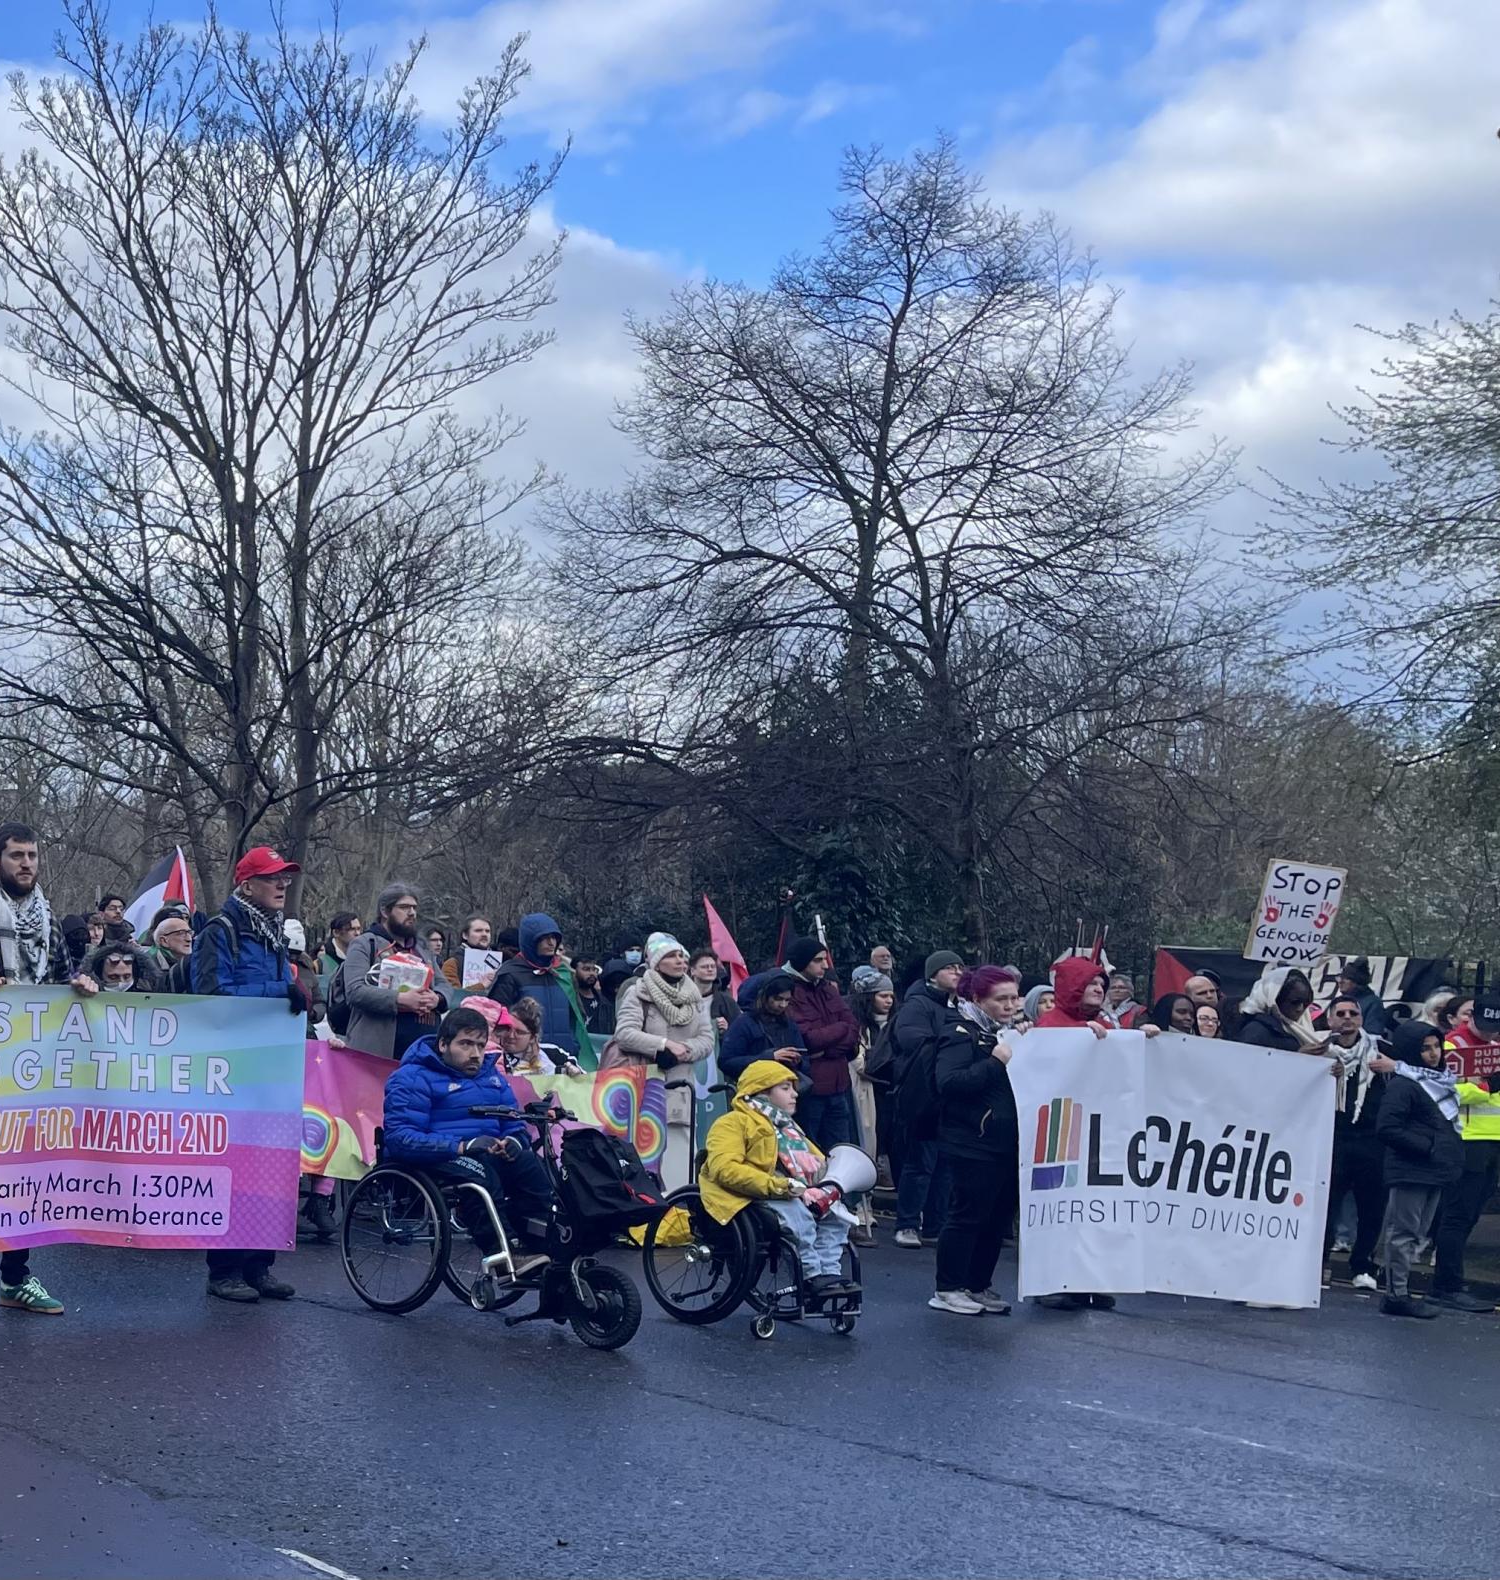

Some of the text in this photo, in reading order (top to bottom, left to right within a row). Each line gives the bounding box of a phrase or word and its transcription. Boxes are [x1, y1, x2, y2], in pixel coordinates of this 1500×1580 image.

[1272, 865, 1341, 900] STOP
[1277, 902, 1316, 918] THE
[1262, 946, 1323, 961] NOW
[1474, 1057, 1500, 1066] HOM
[1475, 1048, 1500, 1057] DUB
[1473, 1065, 1500, 1074] AWA
[35, 1107, 75, 1151] FOR
[80, 1107, 173, 1154] MARCH
[178, 1112, 229, 1155] 2ND
[45, 1172, 121, 1197] March
[132, 1174, 214, 1199] 1:30PM
[19, 1199, 38, 1226] of
[41, 1200, 224, 1226] Rememberance
[1192, 1207, 1300, 1240] DIVISION
